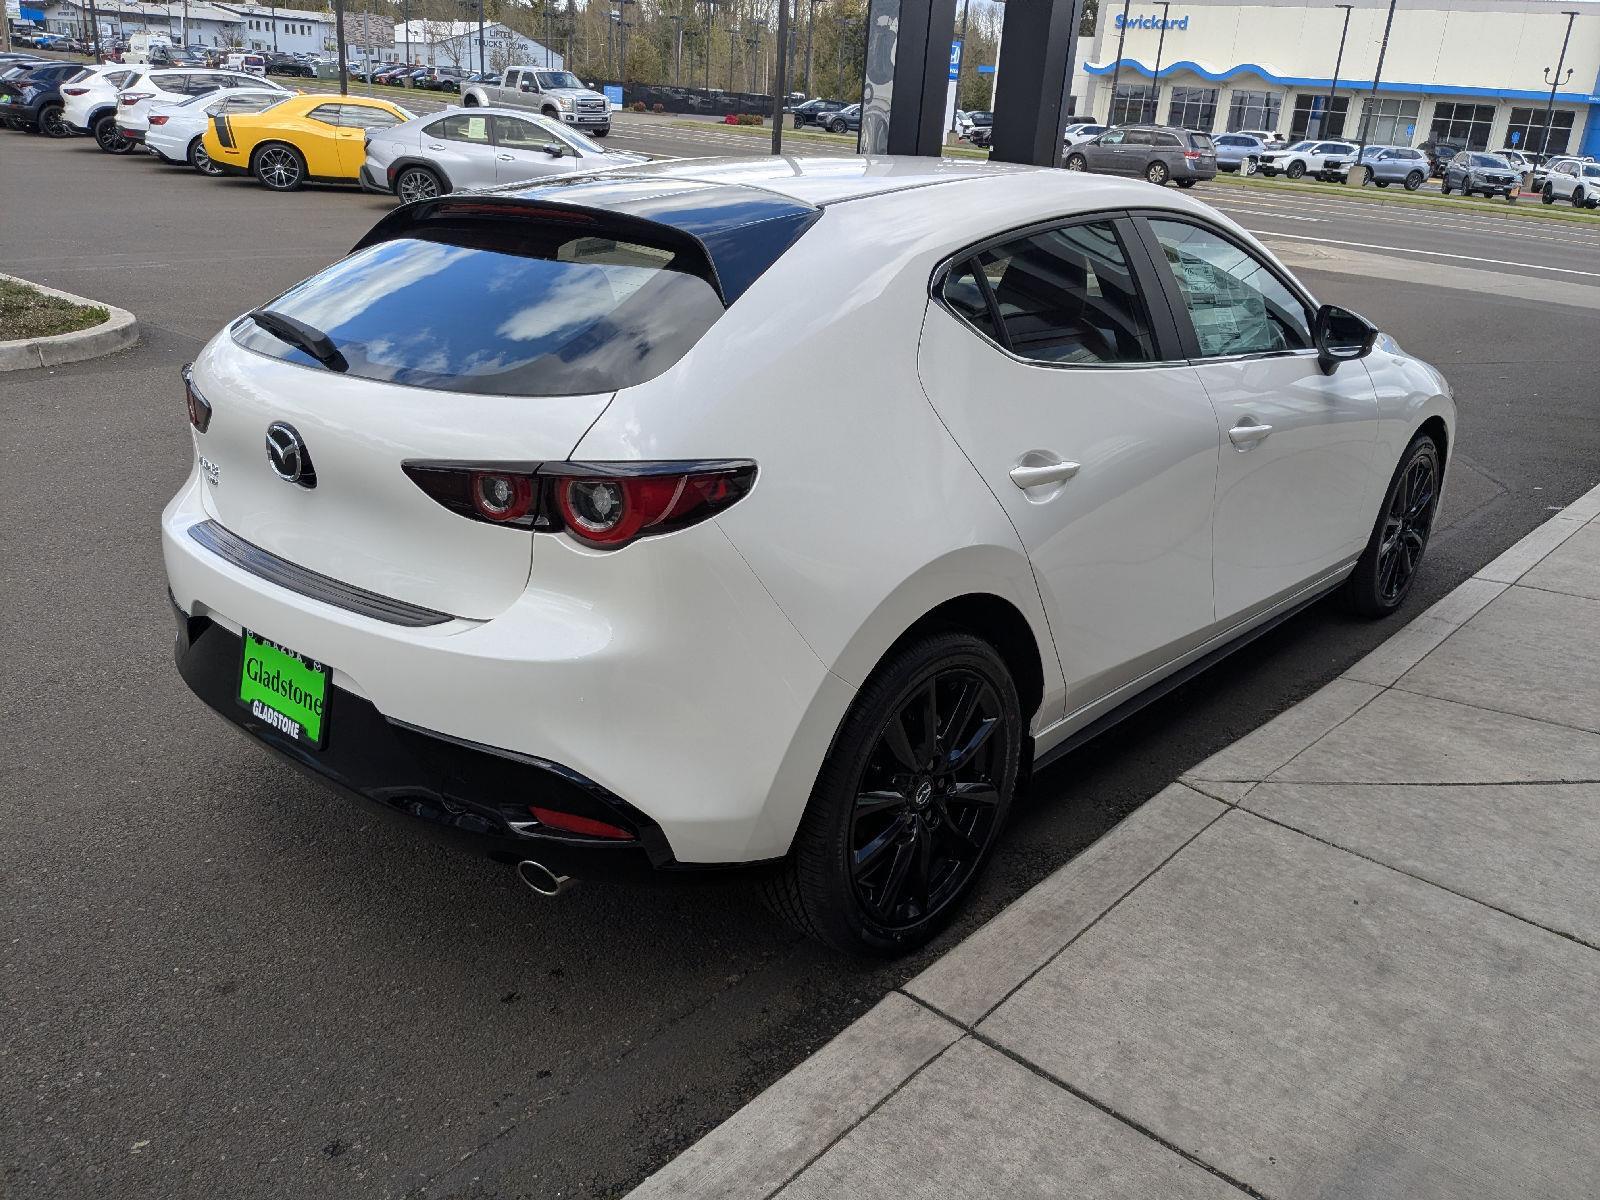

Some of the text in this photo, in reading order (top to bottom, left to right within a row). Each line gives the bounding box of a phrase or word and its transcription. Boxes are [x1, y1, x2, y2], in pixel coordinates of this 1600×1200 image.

[1115, 13, 1189, 30] Swickard
[246, 657, 324, 716] Gladstone
[252, 700, 300, 739] GLADSTONE
